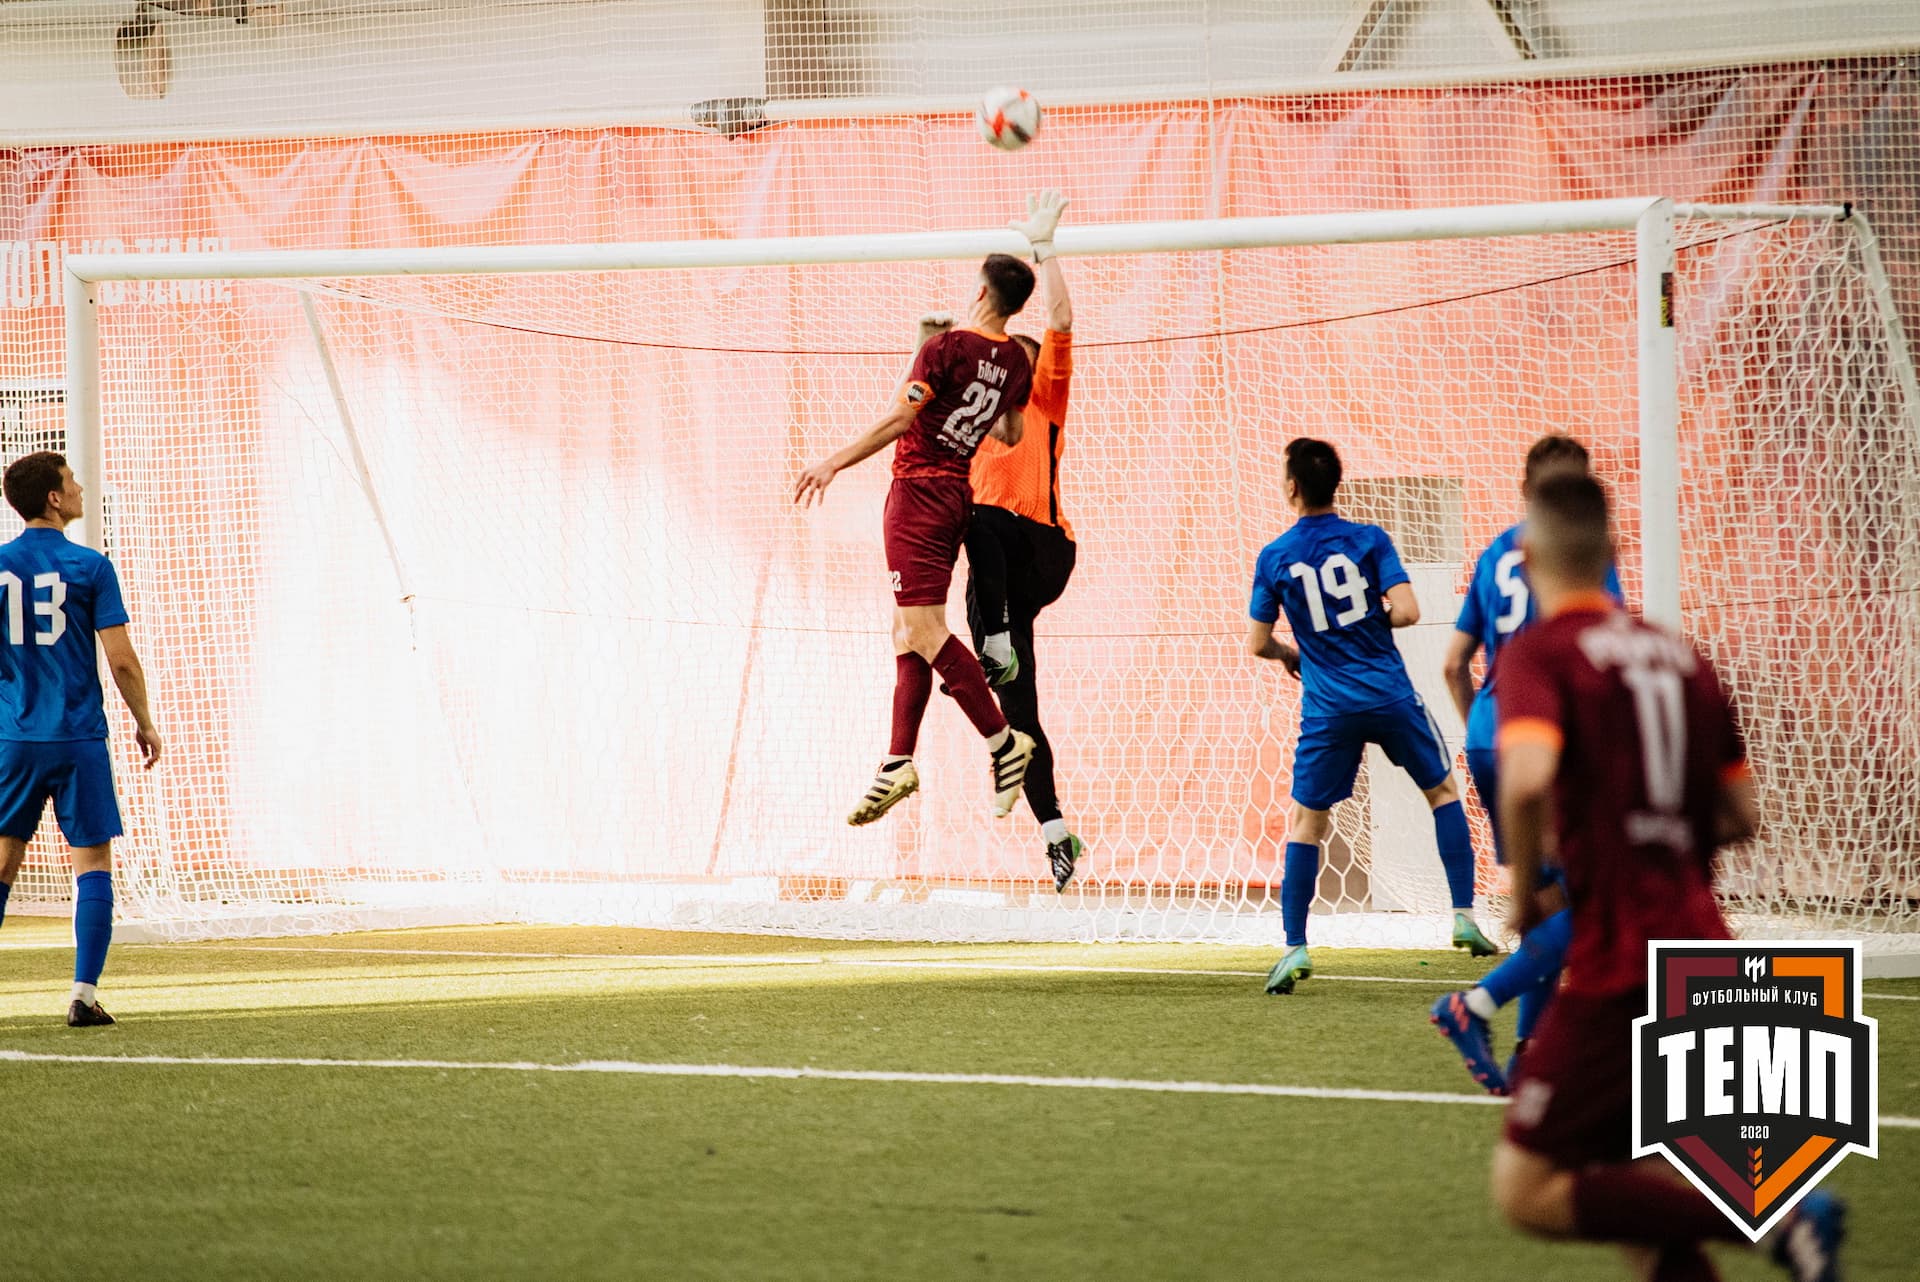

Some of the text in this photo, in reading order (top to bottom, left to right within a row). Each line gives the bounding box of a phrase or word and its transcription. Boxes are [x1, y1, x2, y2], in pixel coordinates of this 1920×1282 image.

[942, 381, 1001, 447] 22
[0, 570, 67, 646] 13
[1289, 553, 1369, 633] 19
[1495, 550, 1529, 633] 5
[1622, 667, 1687, 811] 11
